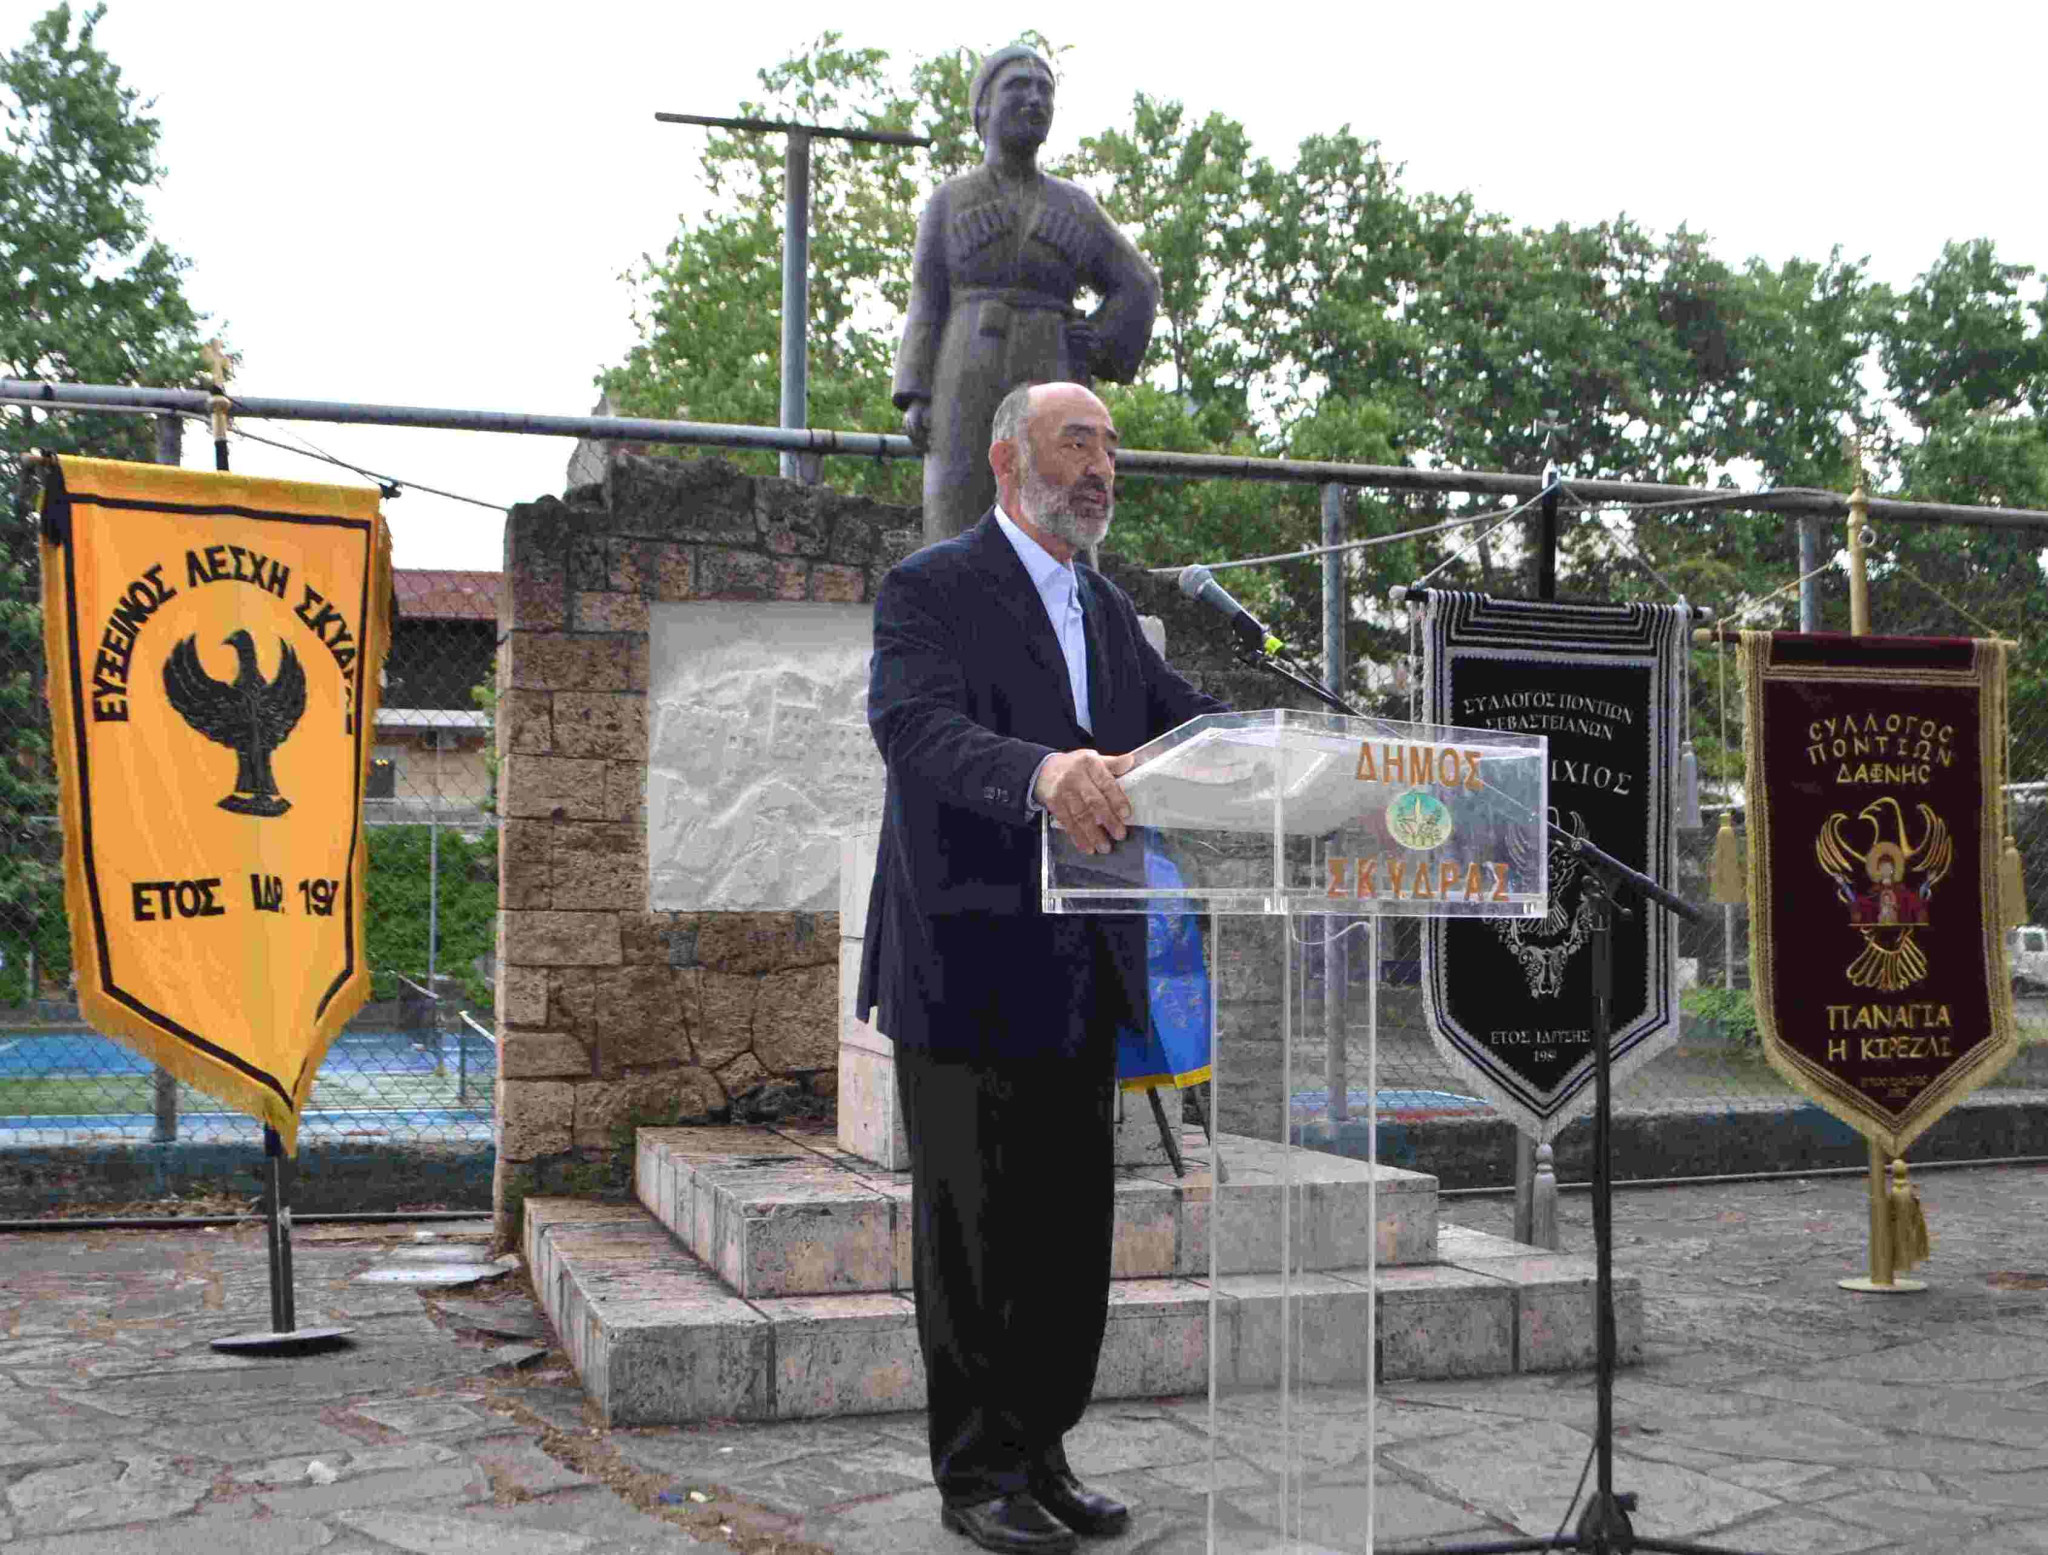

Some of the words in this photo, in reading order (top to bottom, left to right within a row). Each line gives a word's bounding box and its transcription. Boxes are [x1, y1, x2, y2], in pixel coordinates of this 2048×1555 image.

[94, 564, 177, 722] ΕΥΞΕΙΝΟΣ
[185, 545, 290, 598] ΛΕΣΧΗ
[1463, 690, 1556, 716] ΣΥΛΛΟΓΟΣ
[1559, 693, 1635, 725] ΠΟΝΤΙΩΝ
[1485, 713, 1616, 742] ΣΕΒΑΣΤΕΙΑΝΩΝ
[1355, 740, 1485, 792] ΔΗΜΟΣ
[1807, 736, 1954, 768] ΠΟΝΤΙΩΝ
[1326, 856, 1511, 902] ΣΚΥΔΡΑΣ
[130, 877, 226, 922] ΕΤΟΣ
[1825, 1004, 1952, 1031] ΠΑΝΑΓΙΑ
[1490, 1030, 1531, 1045] ΕΤΟΣ
[1827, 1038, 1848, 1062] Η
